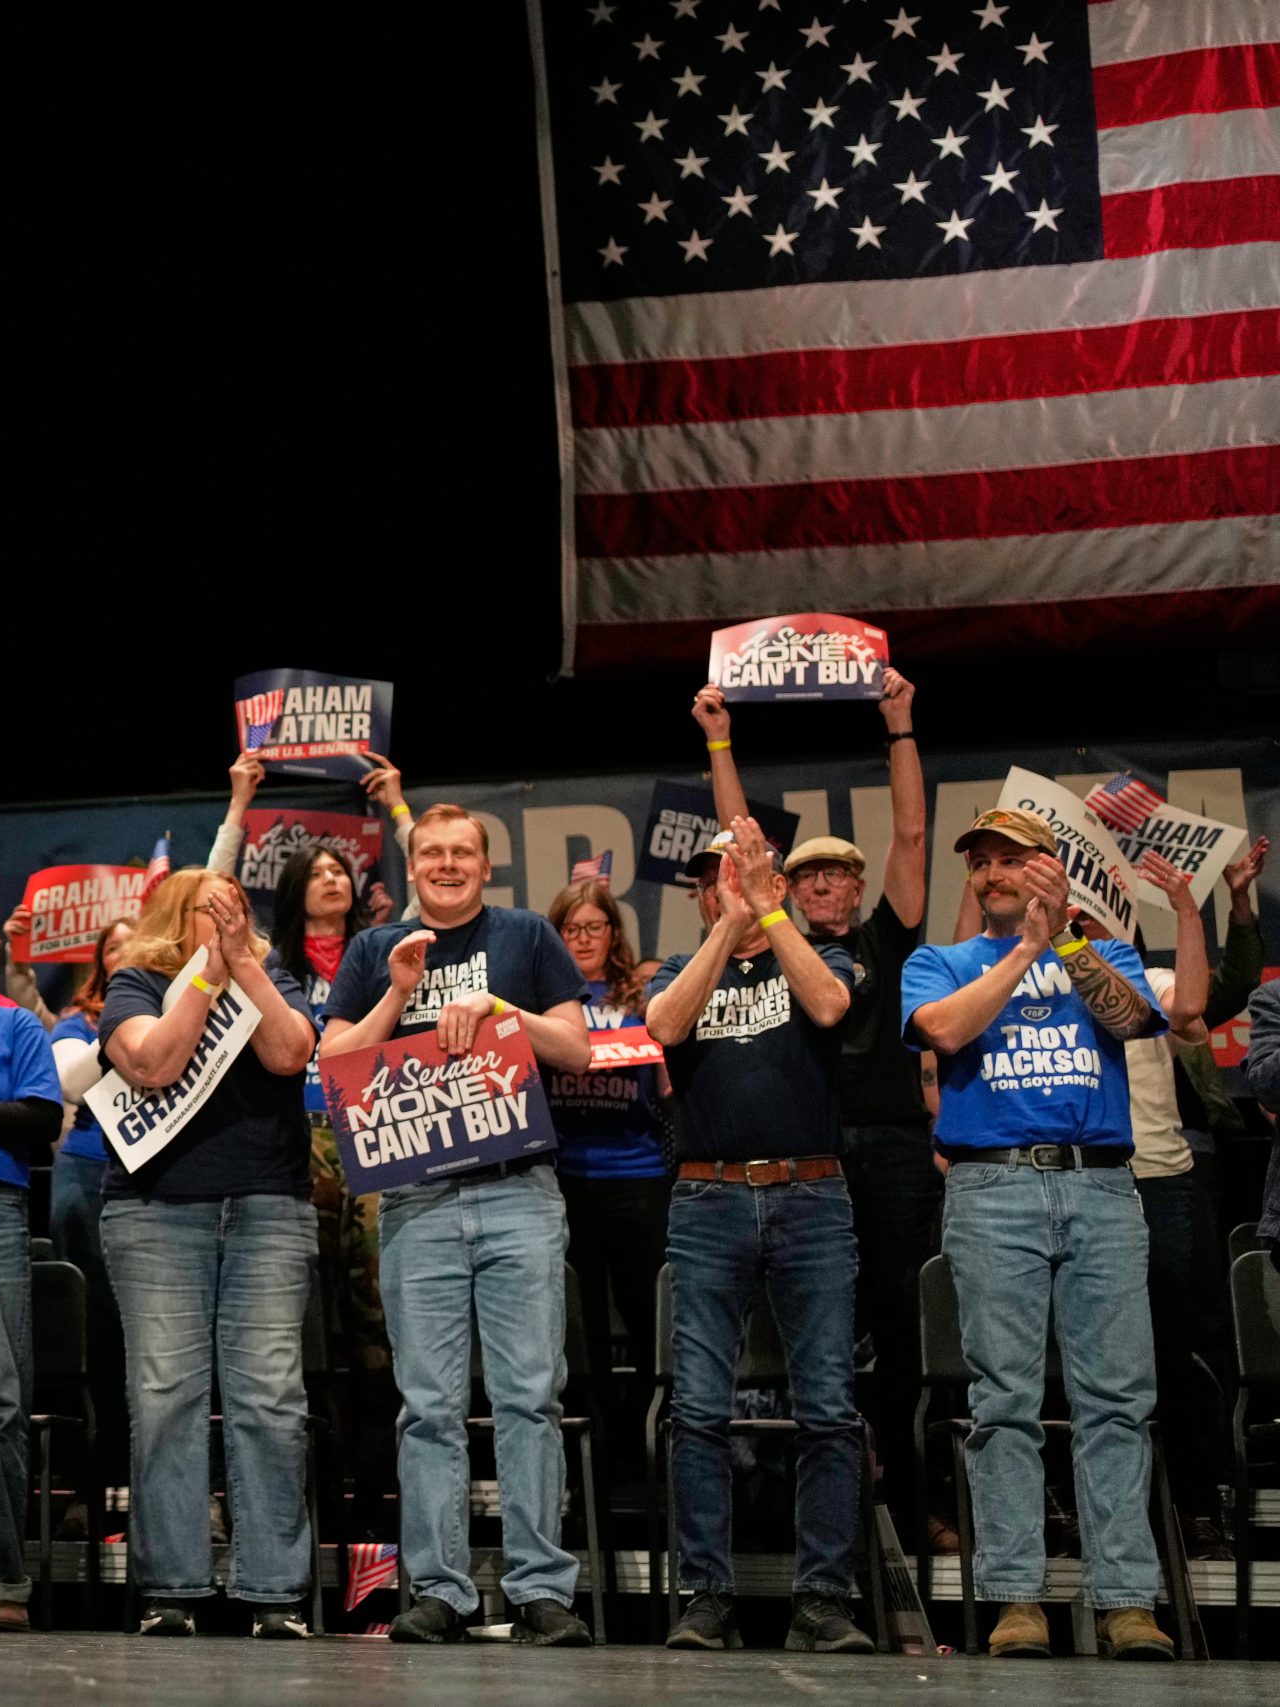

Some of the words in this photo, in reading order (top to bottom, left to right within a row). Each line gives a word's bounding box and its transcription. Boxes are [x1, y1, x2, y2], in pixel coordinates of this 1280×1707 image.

[739, 631, 768, 652] A
[772, 627, 864, 646] Senator
[723, 644, 875, 667] MONEY
[722, 662, 809, 688] CAN'T
[818, 660, 878, 685] BUY
[284, 685, 372, 715] AHAM
[282, 745, 306, 757] U.S.
[309, 742, 358, 756] SENATE
[660, 809, 720, 834] SENI
[1136, 817, 1224, 849] AHAM
[32, 873, 144, 913] GRAHAM
[1056, 838, 1132, 931] AHAM
[1069, 889, 1107, 918] SENATE.COM
[706, 974, 789, 1008] RAHAM
[408, 1012, 428, 1021] FOR
[697, 990, 790, 1029] PLATNER
[703, 1028, 724, 1037] FOR
[1000, 1023, 1079, 1050] TROY
[361, 1066, 395, 1102] A
[399, 1051, 502, 1092] Senator
[990, 1079, 1019, 1092] FOR
[345, 1064, 519, 1132] MONEY
[353, 1111, 453, 1168] CAN'T
[461, 1091, 529, 1143] BUY
